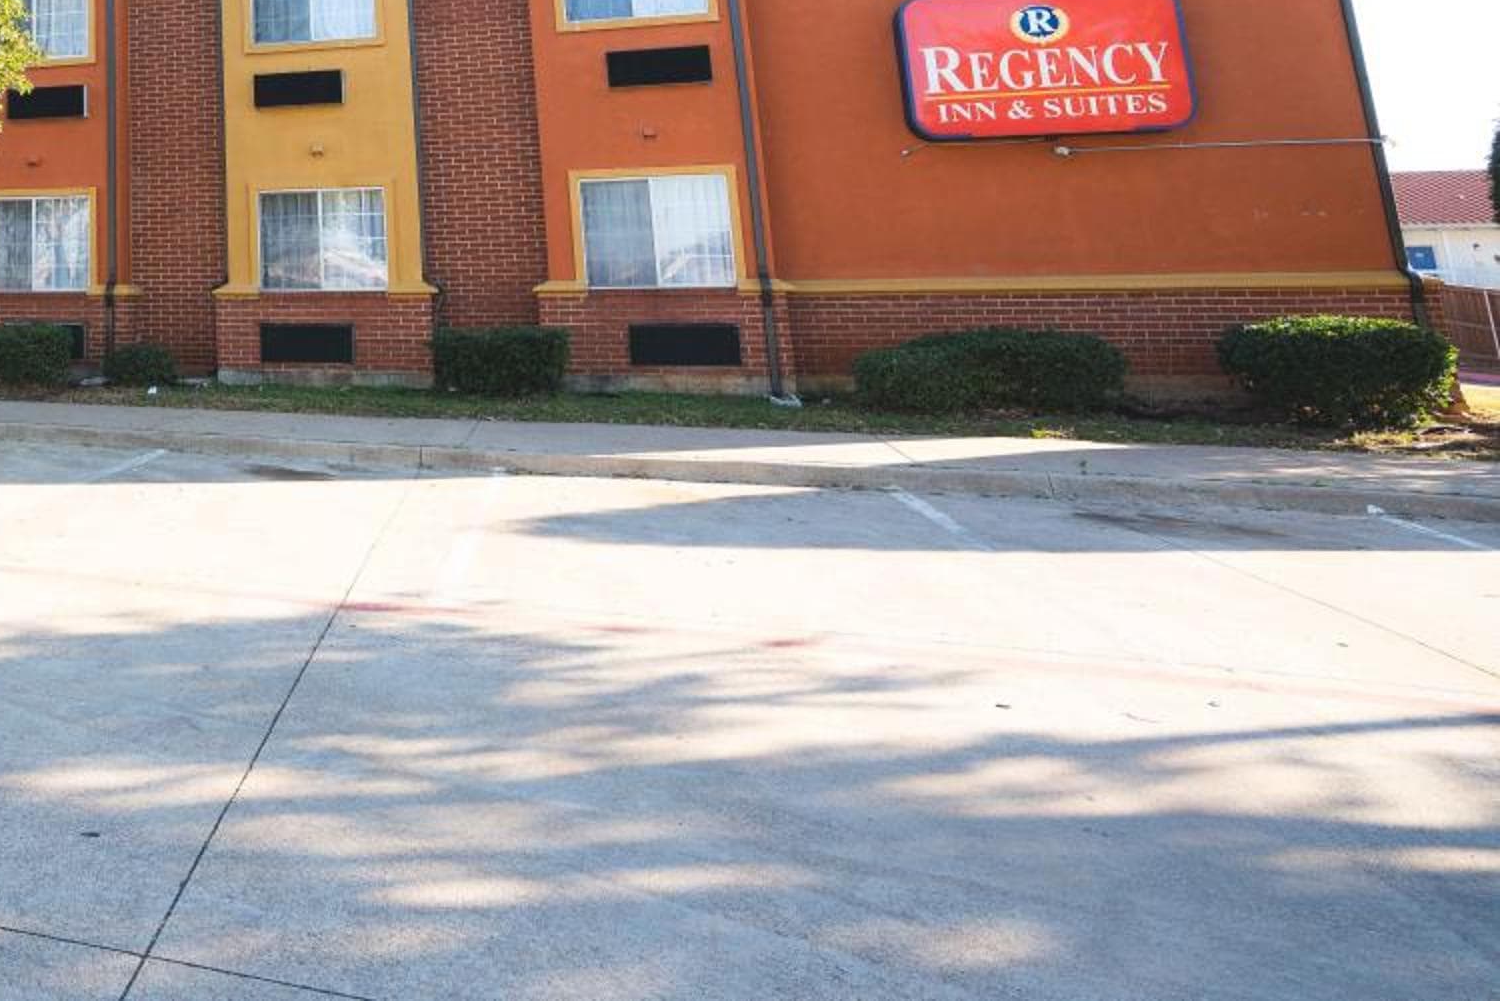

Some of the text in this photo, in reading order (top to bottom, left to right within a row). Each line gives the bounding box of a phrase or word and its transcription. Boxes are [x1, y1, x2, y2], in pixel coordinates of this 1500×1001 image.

[1026, 7, 1054, 34] R
[921, 41, 1169, 94] REGENCY
[938, 93, 1168, 122] INN & SUITES
